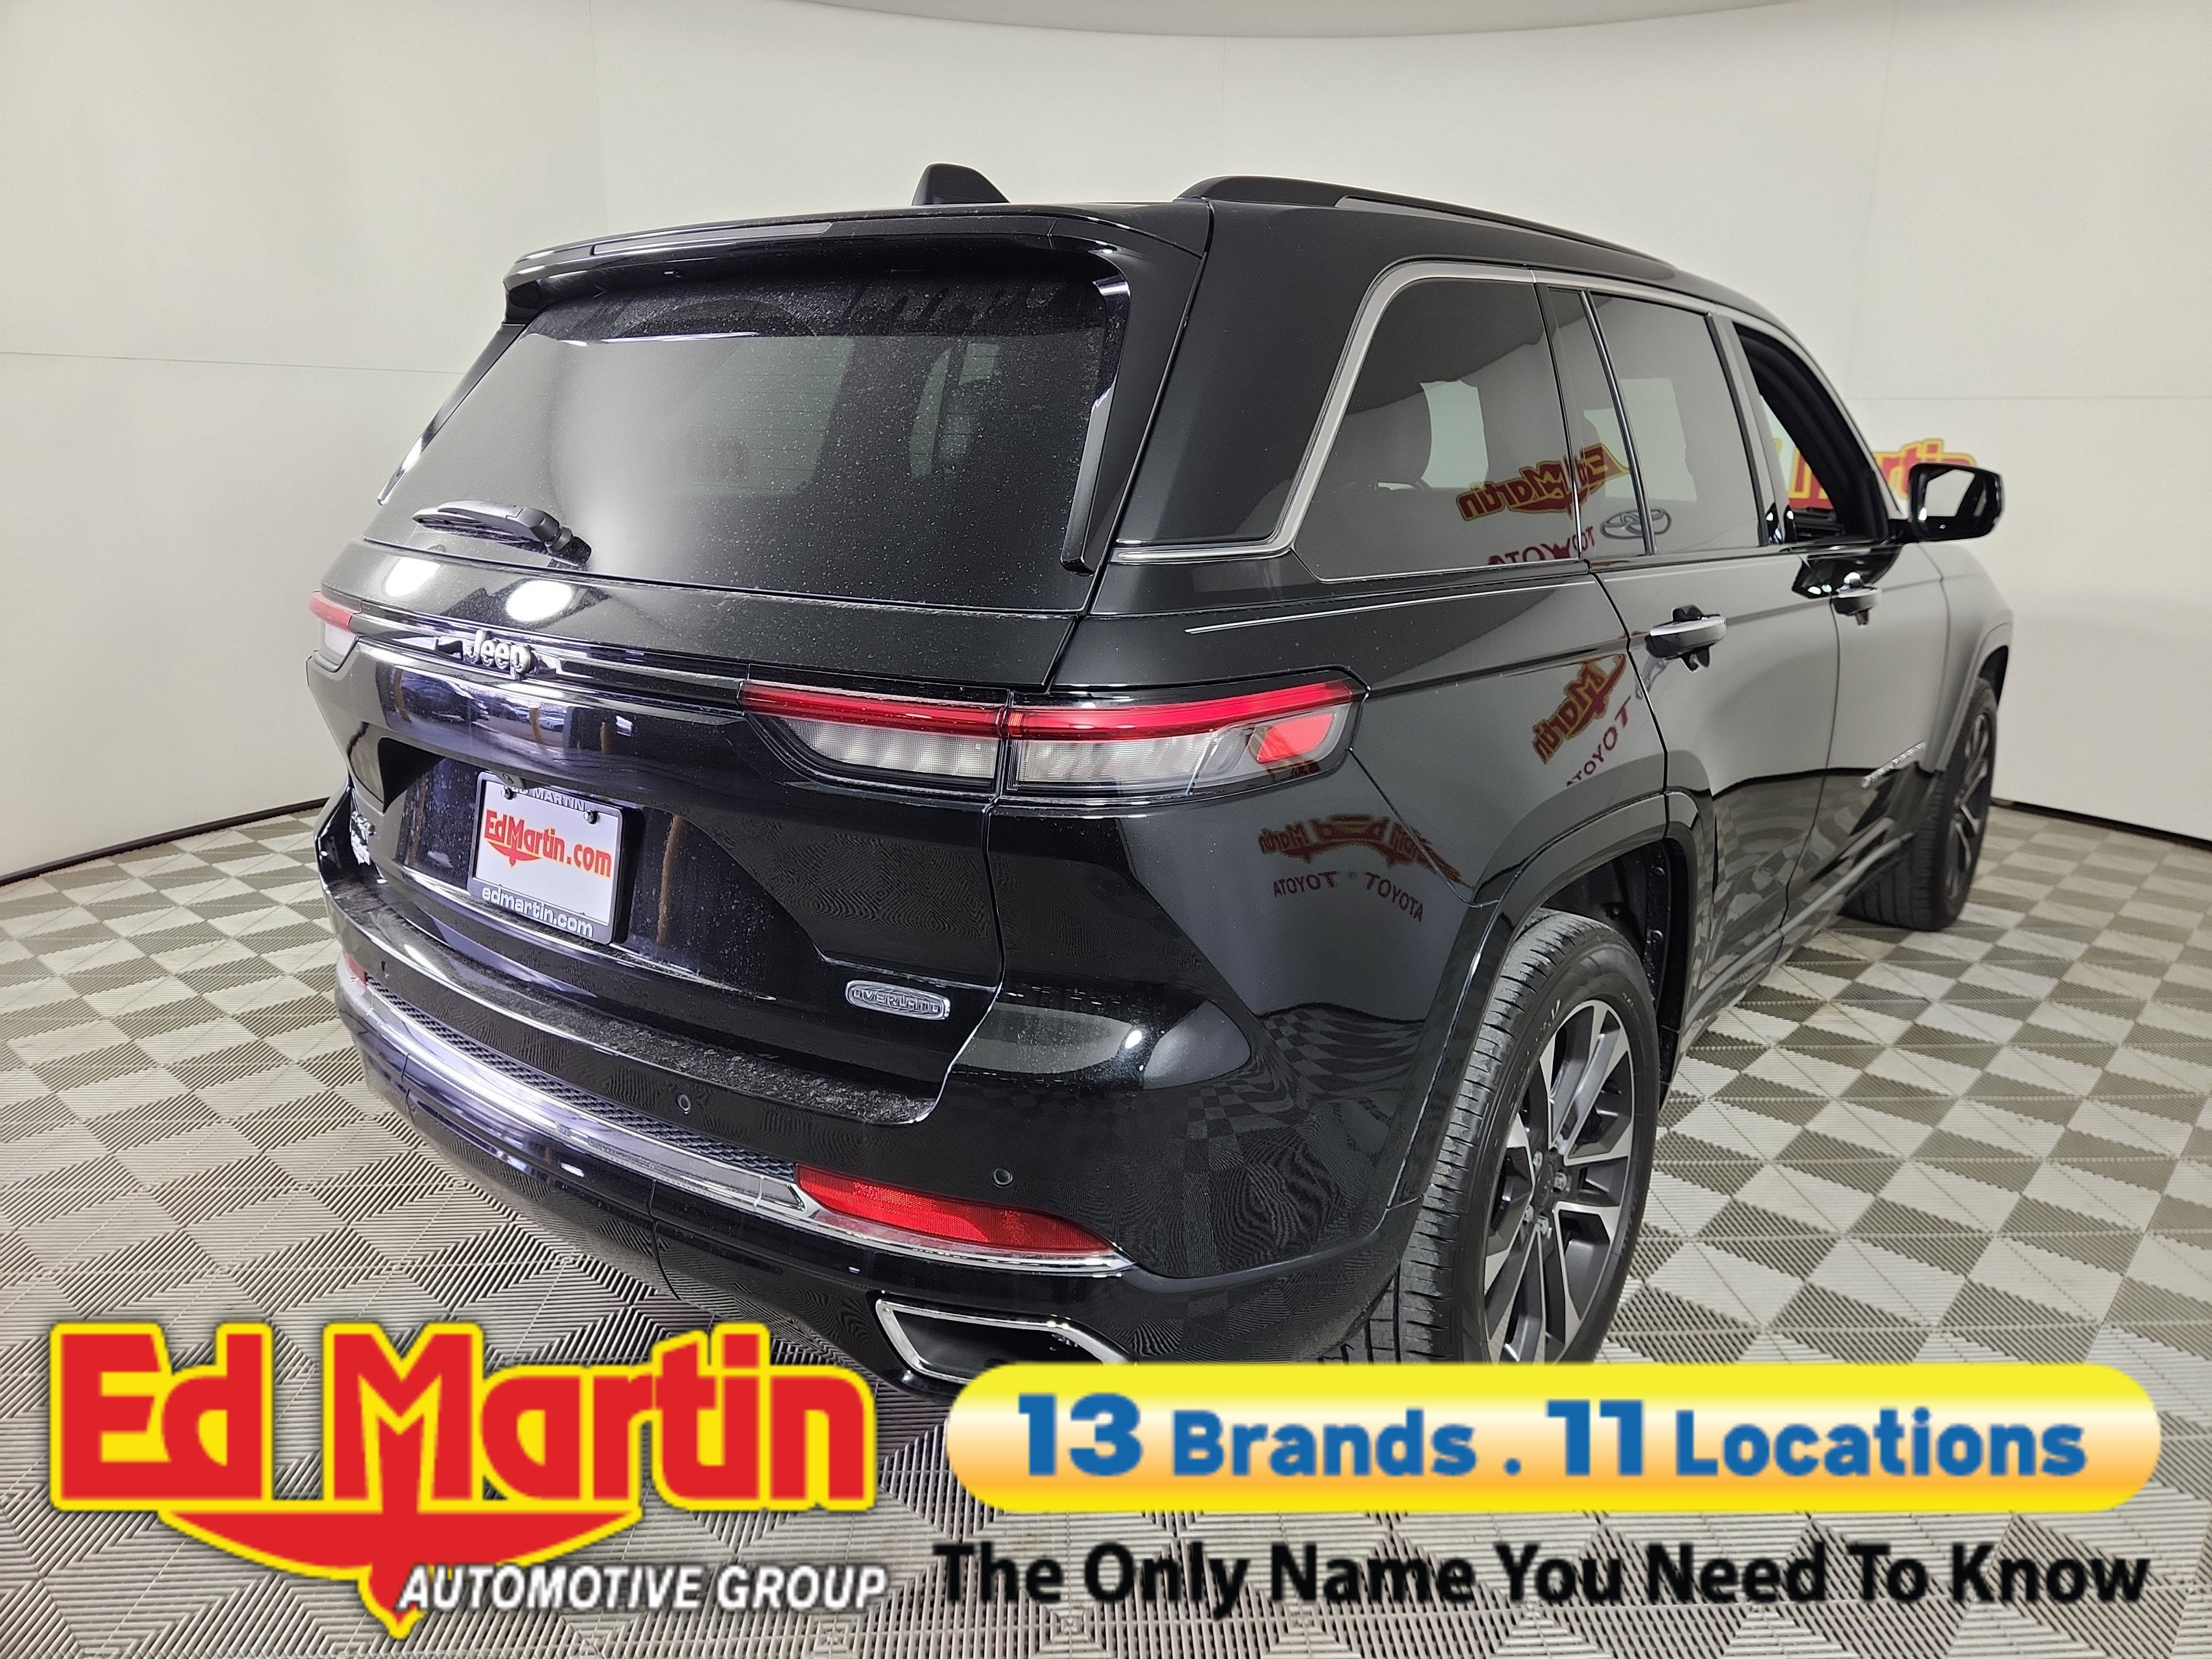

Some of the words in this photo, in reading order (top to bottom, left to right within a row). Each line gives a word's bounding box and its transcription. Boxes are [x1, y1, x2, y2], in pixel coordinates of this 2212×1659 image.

[462, 629, 531, 680] Jeep
[532, 787, 586, 812] MARTIN
[484, 809, 612, 878] EdMartin.com
[481, 886, 594, 938] edmartin.com
[1366, 871, 1423, 922] TOYOTA
[852, 988, 942, 1013] OVERLAND
